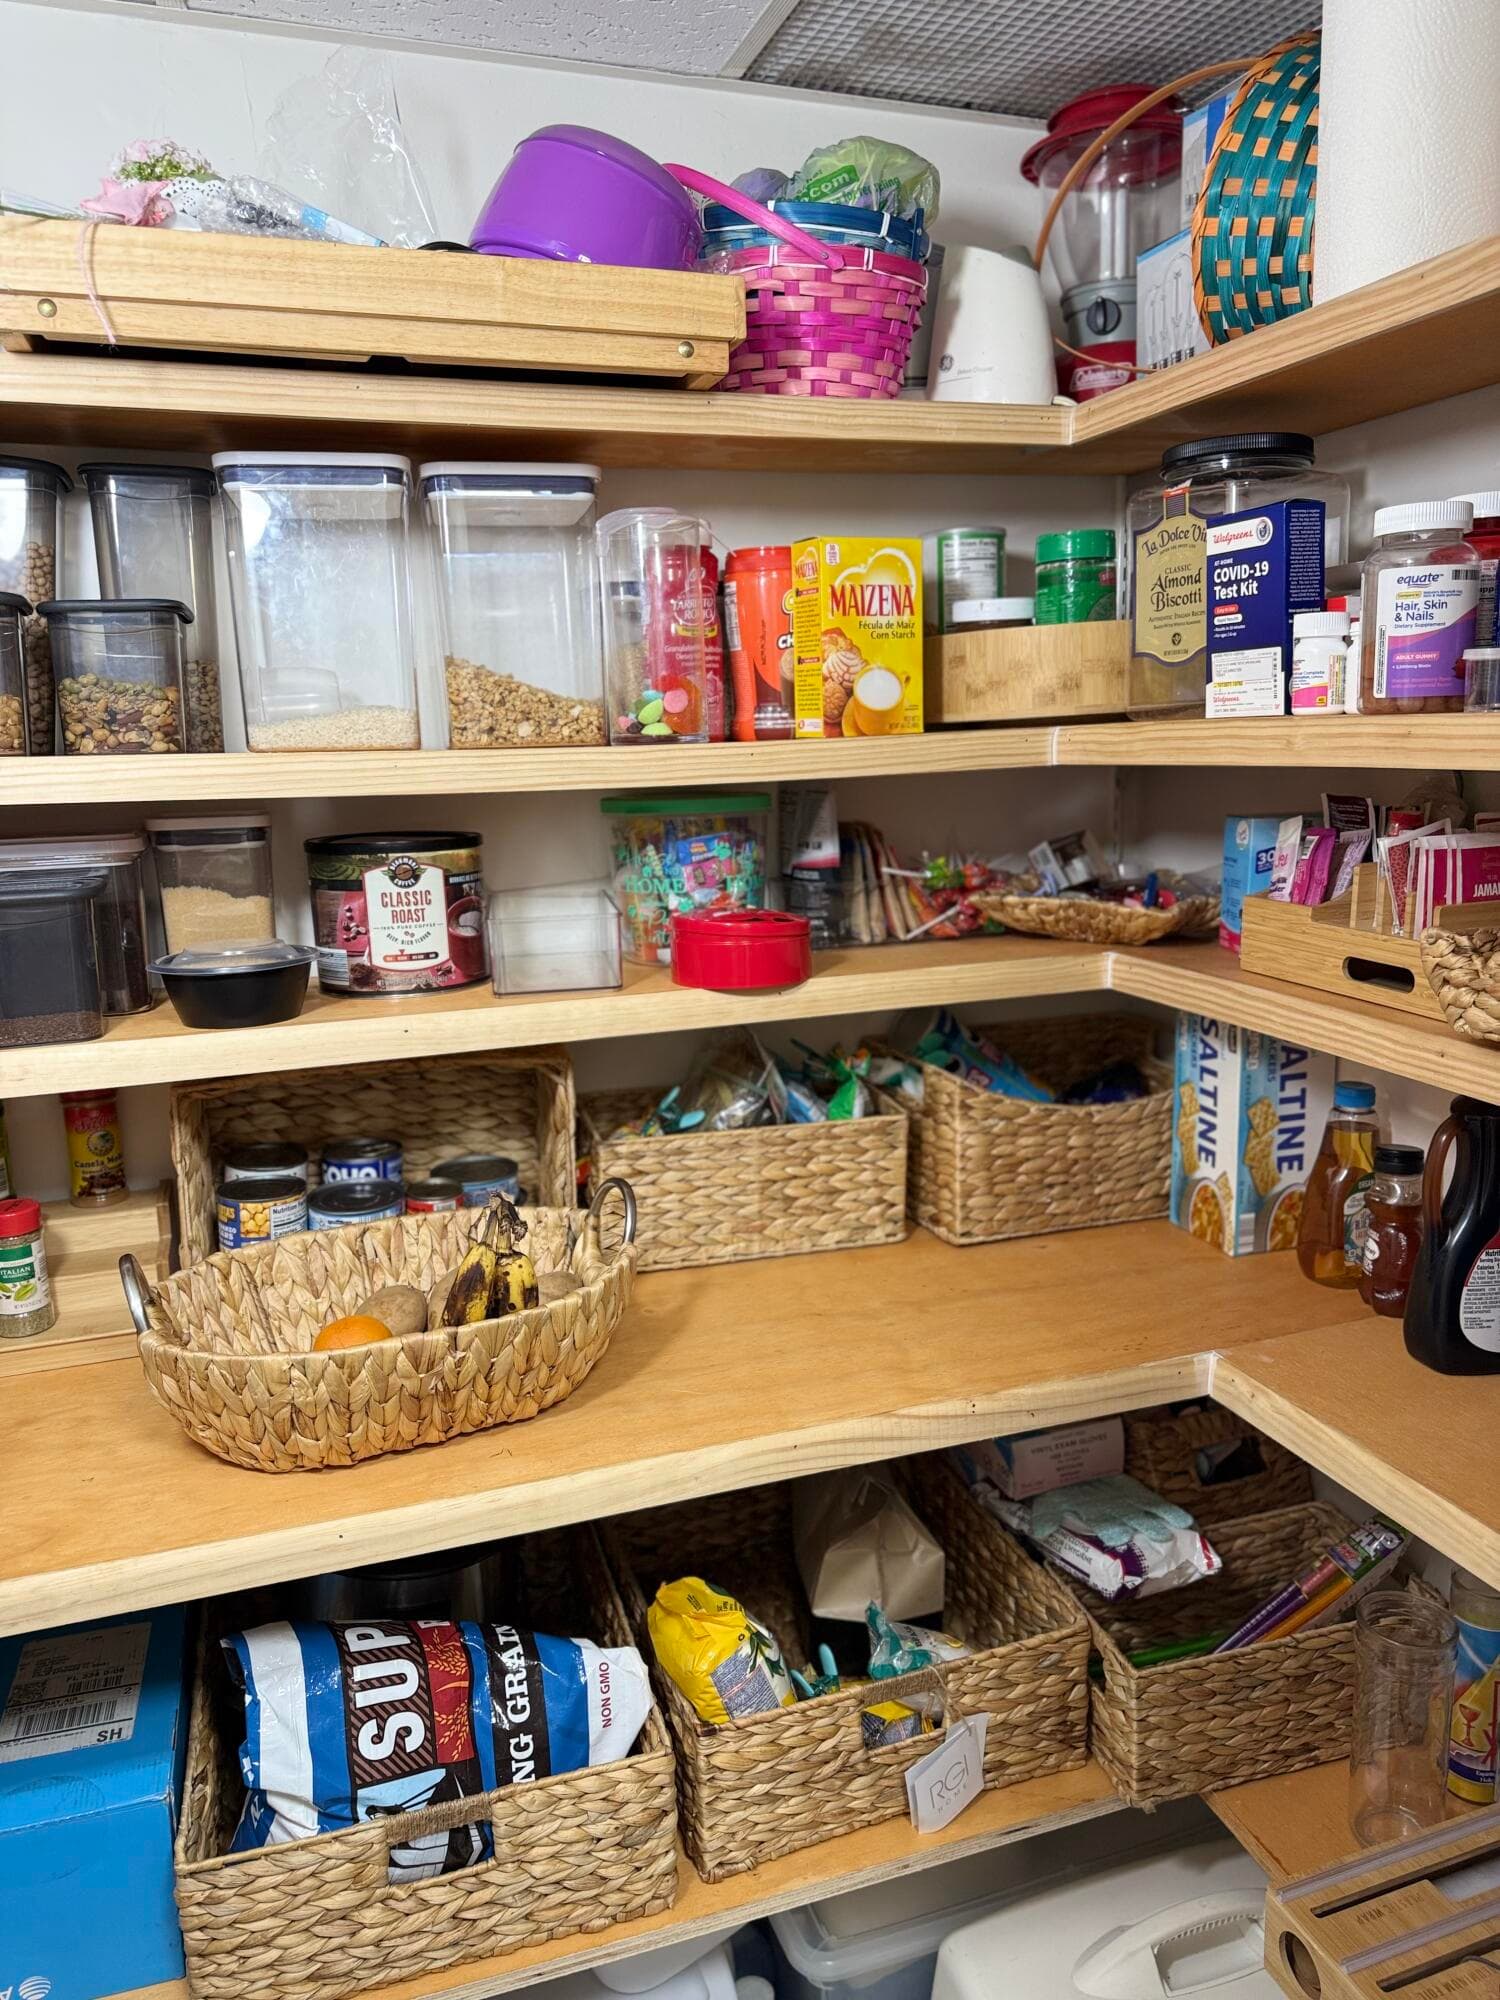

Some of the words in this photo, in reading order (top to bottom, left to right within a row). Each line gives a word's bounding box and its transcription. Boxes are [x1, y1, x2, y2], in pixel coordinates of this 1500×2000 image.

[1158, 526, 1190, 548] Dolce
[1213, 529, 1254, 544] Walgreens
[796, 560, 818, 579] MAIZENA
[1164, 564, 1192, 575] CLASSIC
[1213, 560, 1269, 583] COVID-19
[1151, 567, 1203, 592] Almond
[1396, 573, 1439, 587] equate
[1213, 583, 1238, 601] Test
[1240, 580, 1259, 597] Kit
[830, 583, 916, 618] MAIZENA
[1150, 588, 1203, 612] Biscotti
[1395, 601, 1421, 612] Hair,
[1423, 599, 1448, 610] Skin
[858, 620, 883, 630] Fécula
[884, 619, 895, 629] de
[1394, 612, 1403, 622] &
[1405, 610, 1434, 621] Nails
[870, 630, 889, 640] Corn
[891, 629, 916, 640] Starch
[624, 874, 686, 894] HOME
[380, 890, 432, 908] CLASSIC
[391, 907, 427, 924] ROAST
[1199, 1015, 1219, 1169] SALTINE
[272, 1204, 297, 1215] Nutrition
[0, 1265, 31, 1276] ITALIAN
[1054, 1439, 1078, 1449] EXAM
[1078, 1433, 1108, 1445] GLOVES
[599, 1662, 611, 1695] GMO
[123, 1687, 132, 1695] 2
[343, 1620, 426, 1761] SUP
[601, 1697, 612, 1729] NON
[96, 1727, 123, 1744] SH
[510, 1733, 536, 1784] NG
[929, 1754, 970, 1809] RGI
[1356, 1908, 1385, 1926] WRAP
